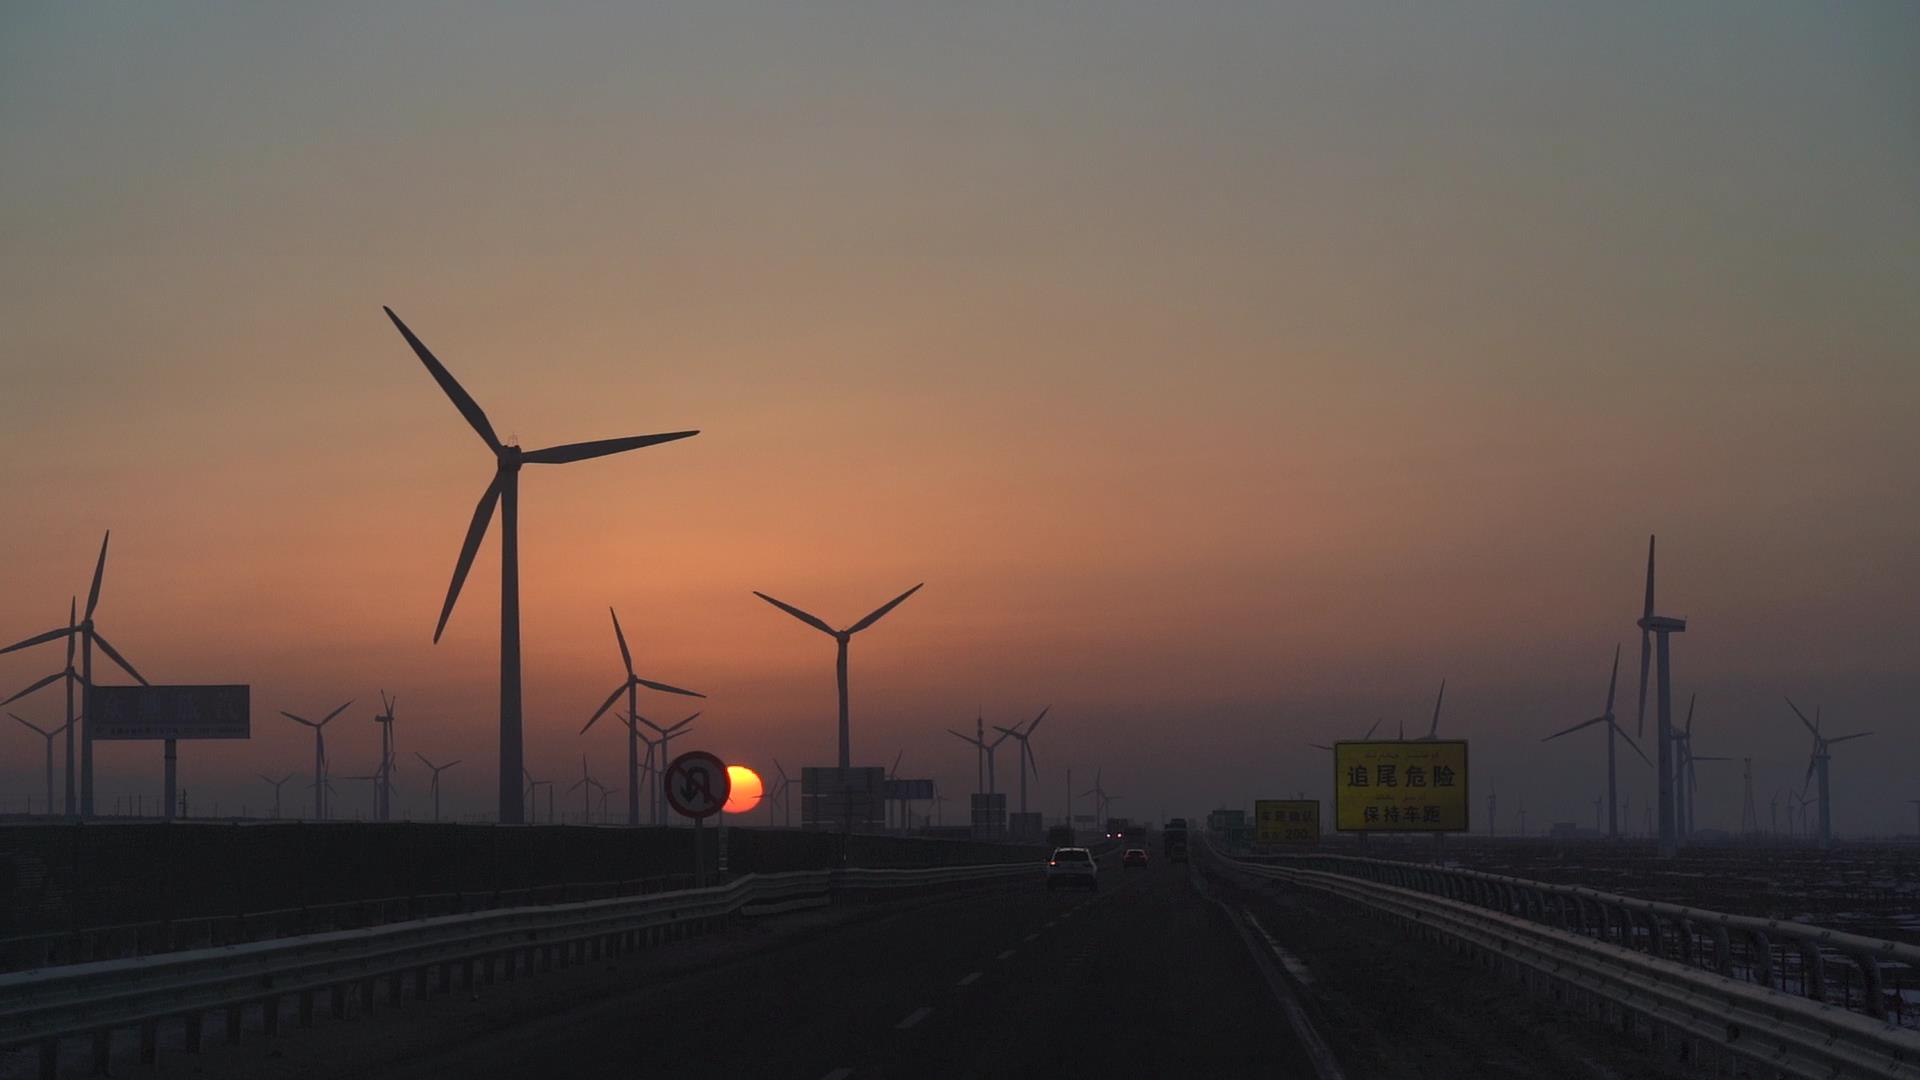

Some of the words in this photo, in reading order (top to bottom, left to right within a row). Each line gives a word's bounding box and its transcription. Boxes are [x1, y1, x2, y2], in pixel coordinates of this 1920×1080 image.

[1347, 764, 1456, 788] 追尾危险
[1363, 805, 1441, 823] 保持车距
